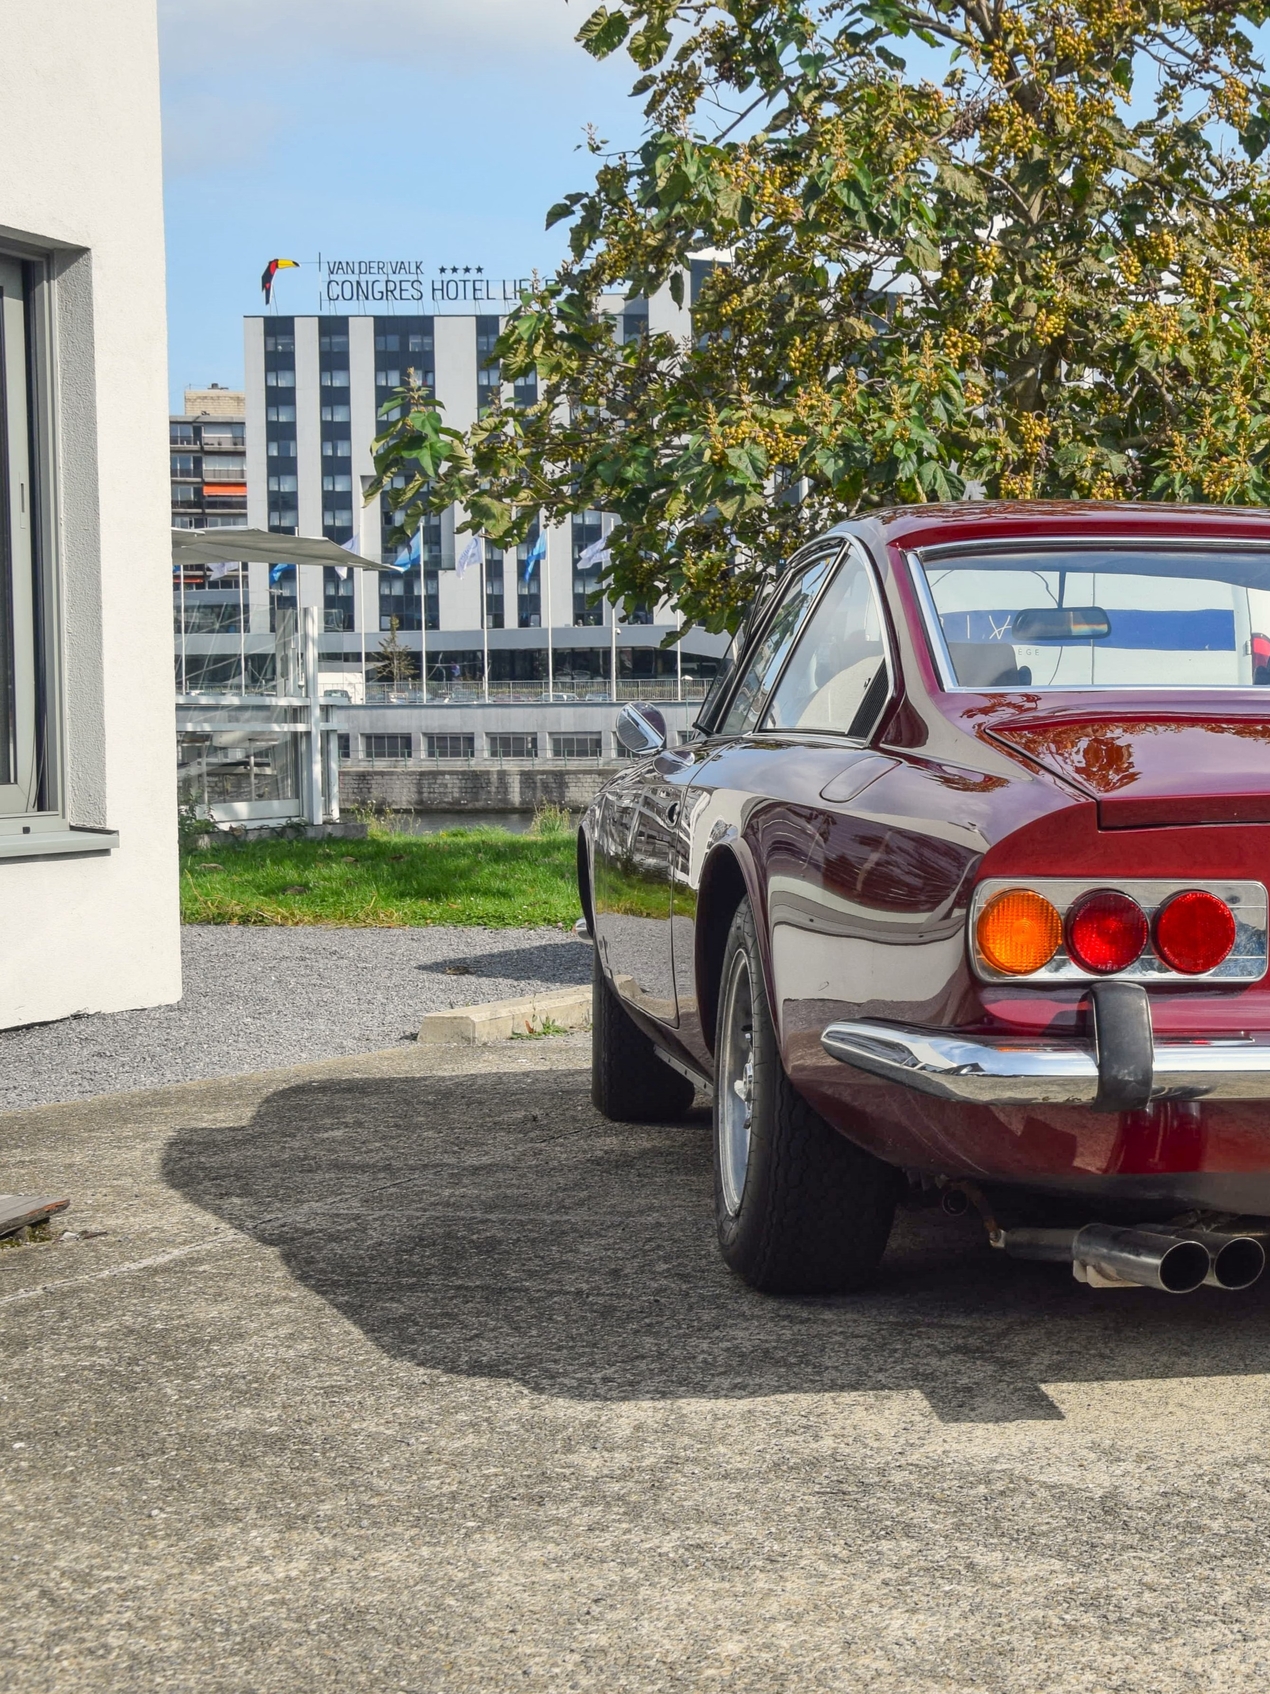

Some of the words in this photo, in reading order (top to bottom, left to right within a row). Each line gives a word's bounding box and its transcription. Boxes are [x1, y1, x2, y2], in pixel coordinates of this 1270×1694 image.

[327, 261, 355, 275] VAN
[359, 261, 387, 275] DER
[389, 261, 425, 275] VALK
[327, 279, 424, 301] CONGRES
[431, 279, 496, 301] HOTEL
